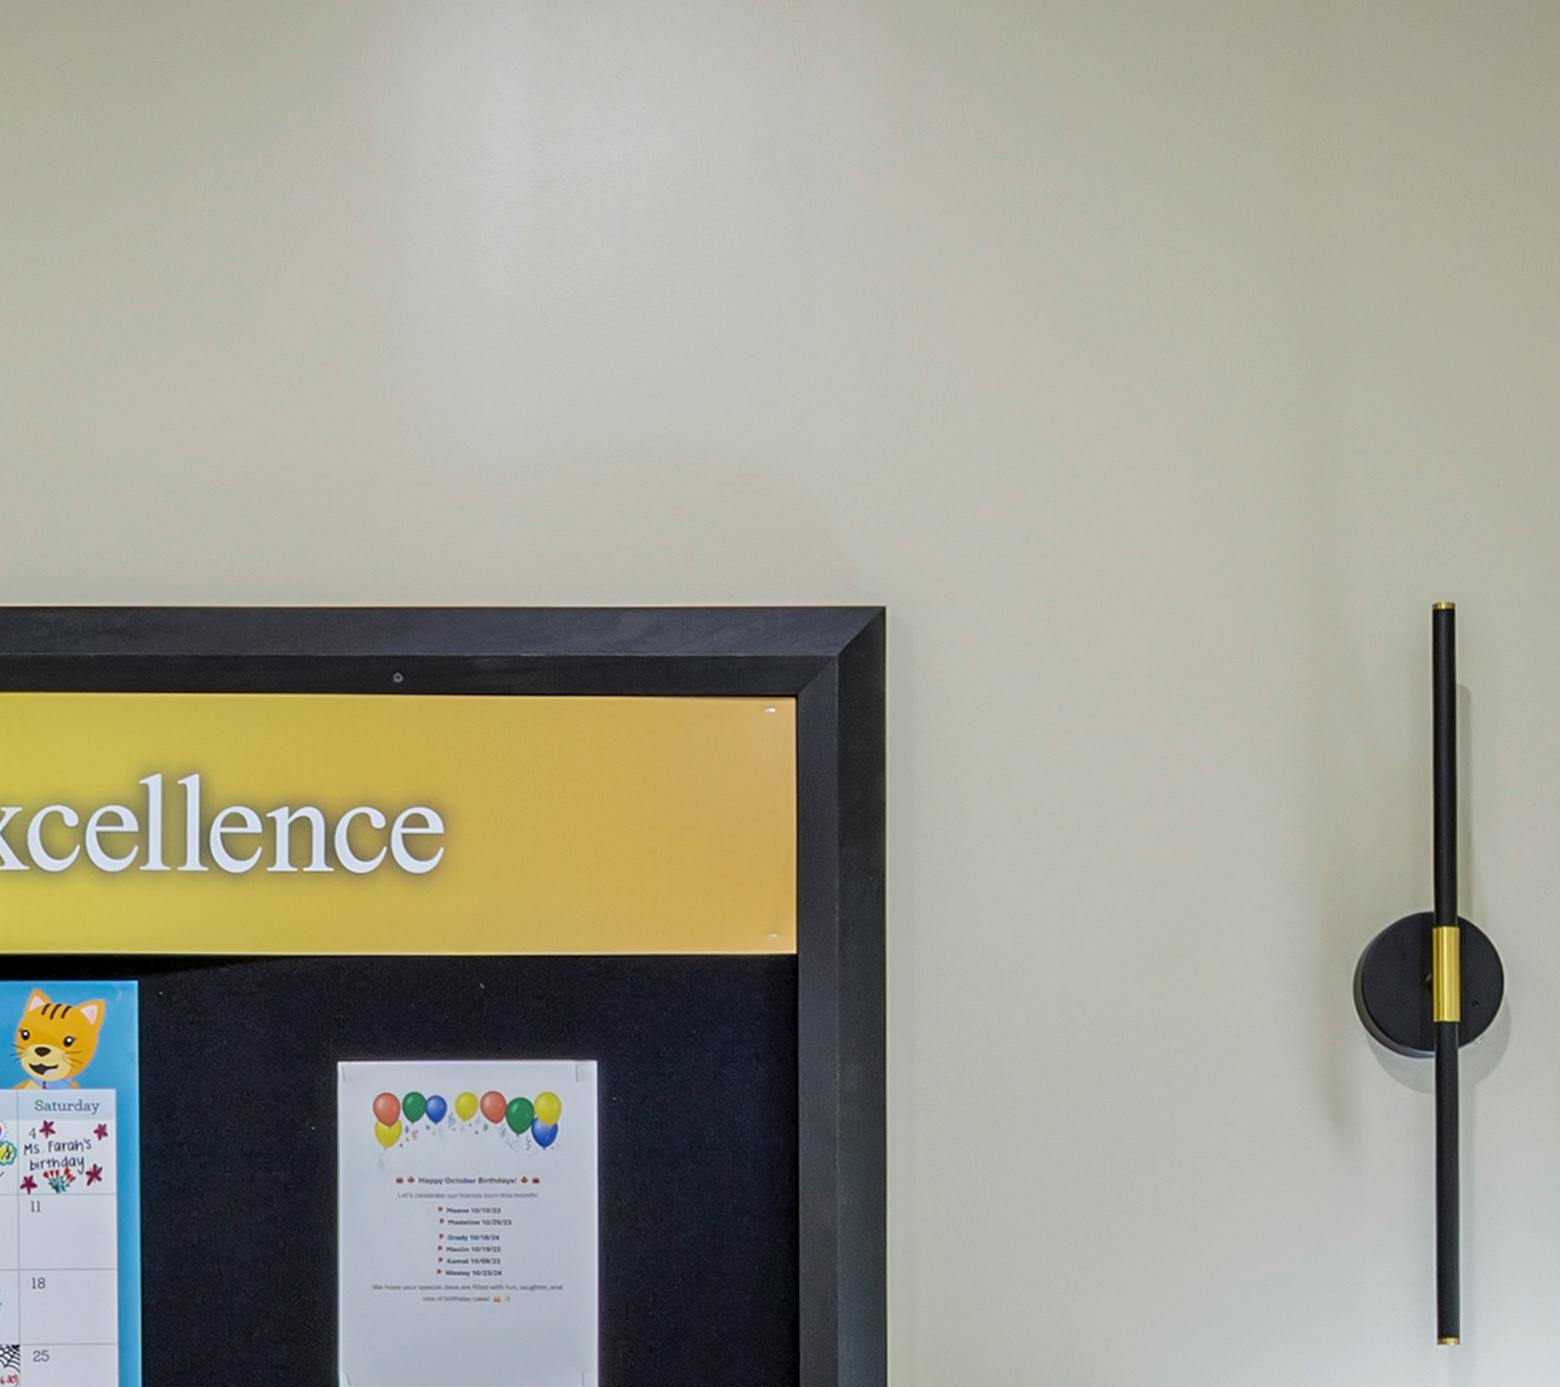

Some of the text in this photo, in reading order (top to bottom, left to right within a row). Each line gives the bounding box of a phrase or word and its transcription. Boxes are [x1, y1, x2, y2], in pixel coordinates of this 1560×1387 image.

[34, 1099, 100, 1114] Saturday
[28, 1128, 37, 1139] 4
[29, 1156, 85, 1175] birthday
[418, 1177, 443, 1185] Happy
[30, 1201, 41, 1212] 11
[32, 1277, 46, 1289] 18
[32, 1350, 50, 1362] 25
